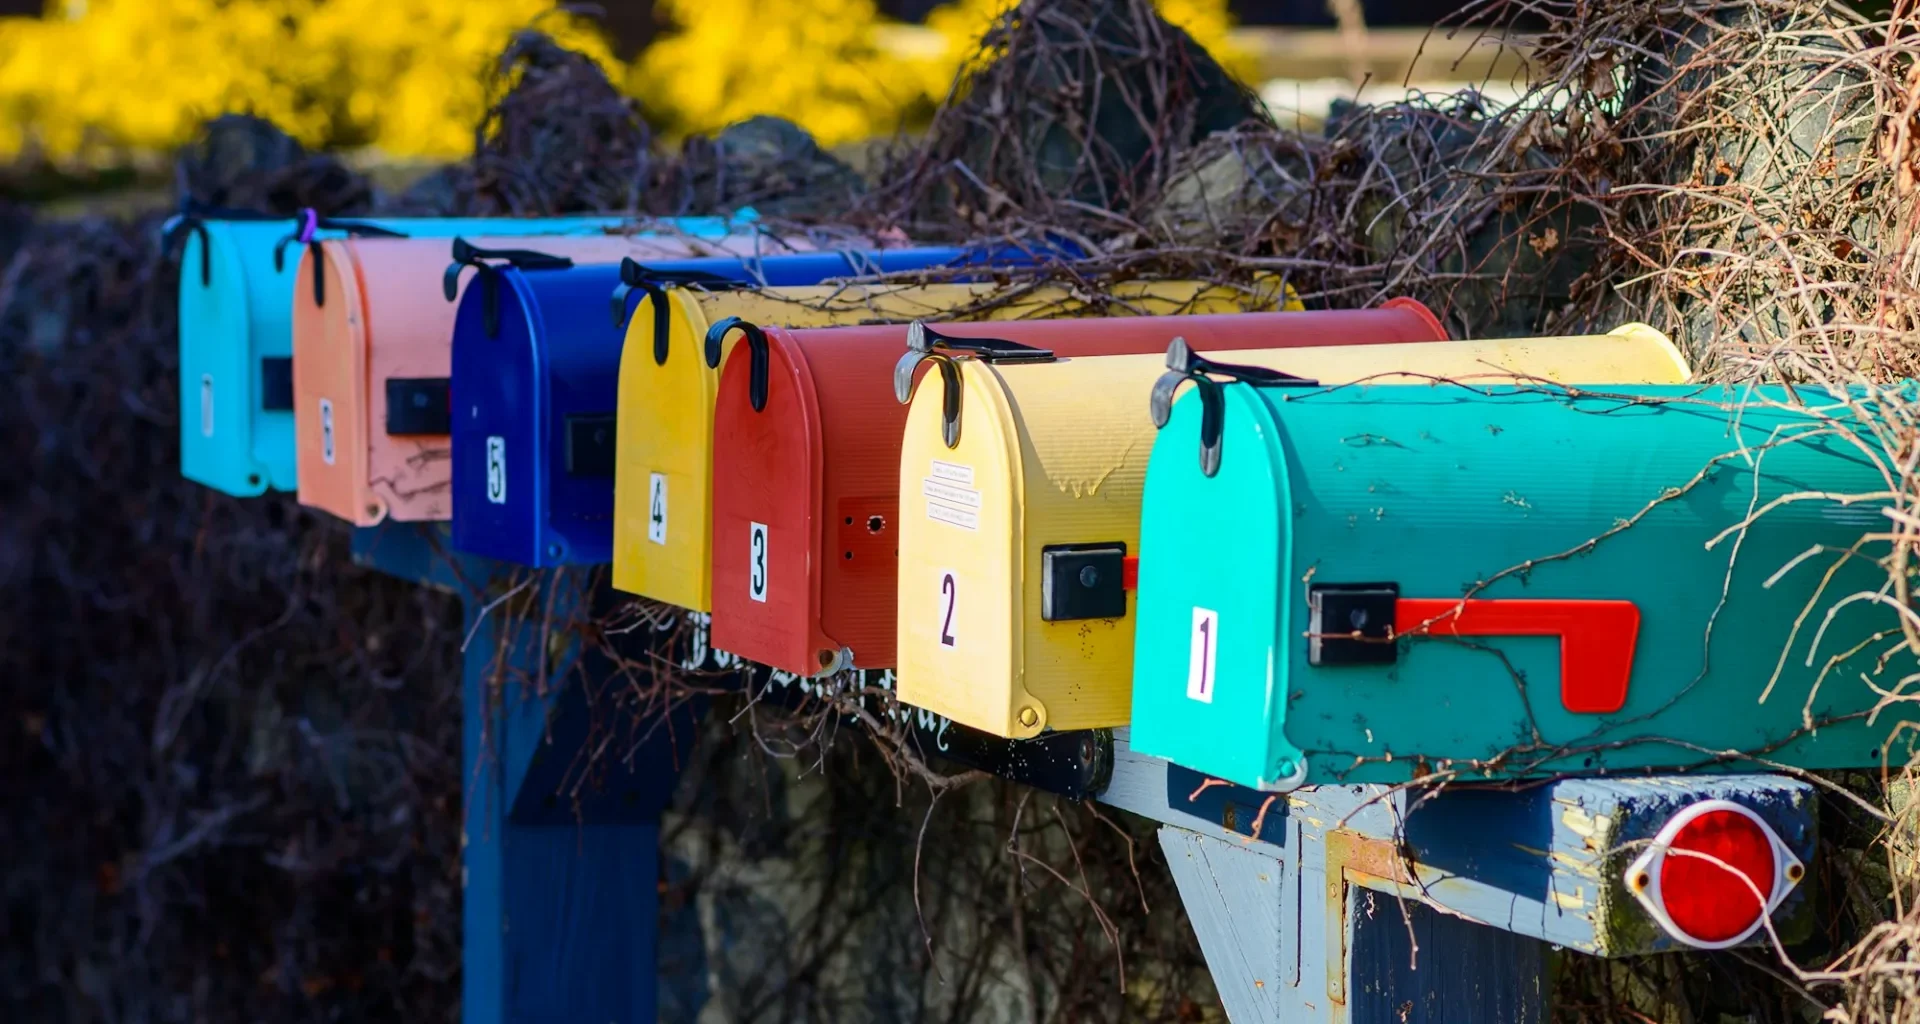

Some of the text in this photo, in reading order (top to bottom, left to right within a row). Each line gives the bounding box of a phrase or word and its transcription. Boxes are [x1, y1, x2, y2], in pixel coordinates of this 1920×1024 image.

[491, 443, 501, 498] 5
[652, 478, 662, 538] 4
[753, 528, 765, 596] 3
[941, 573, 955, 647] 2
[1199, 617, 1210, 694] 1
